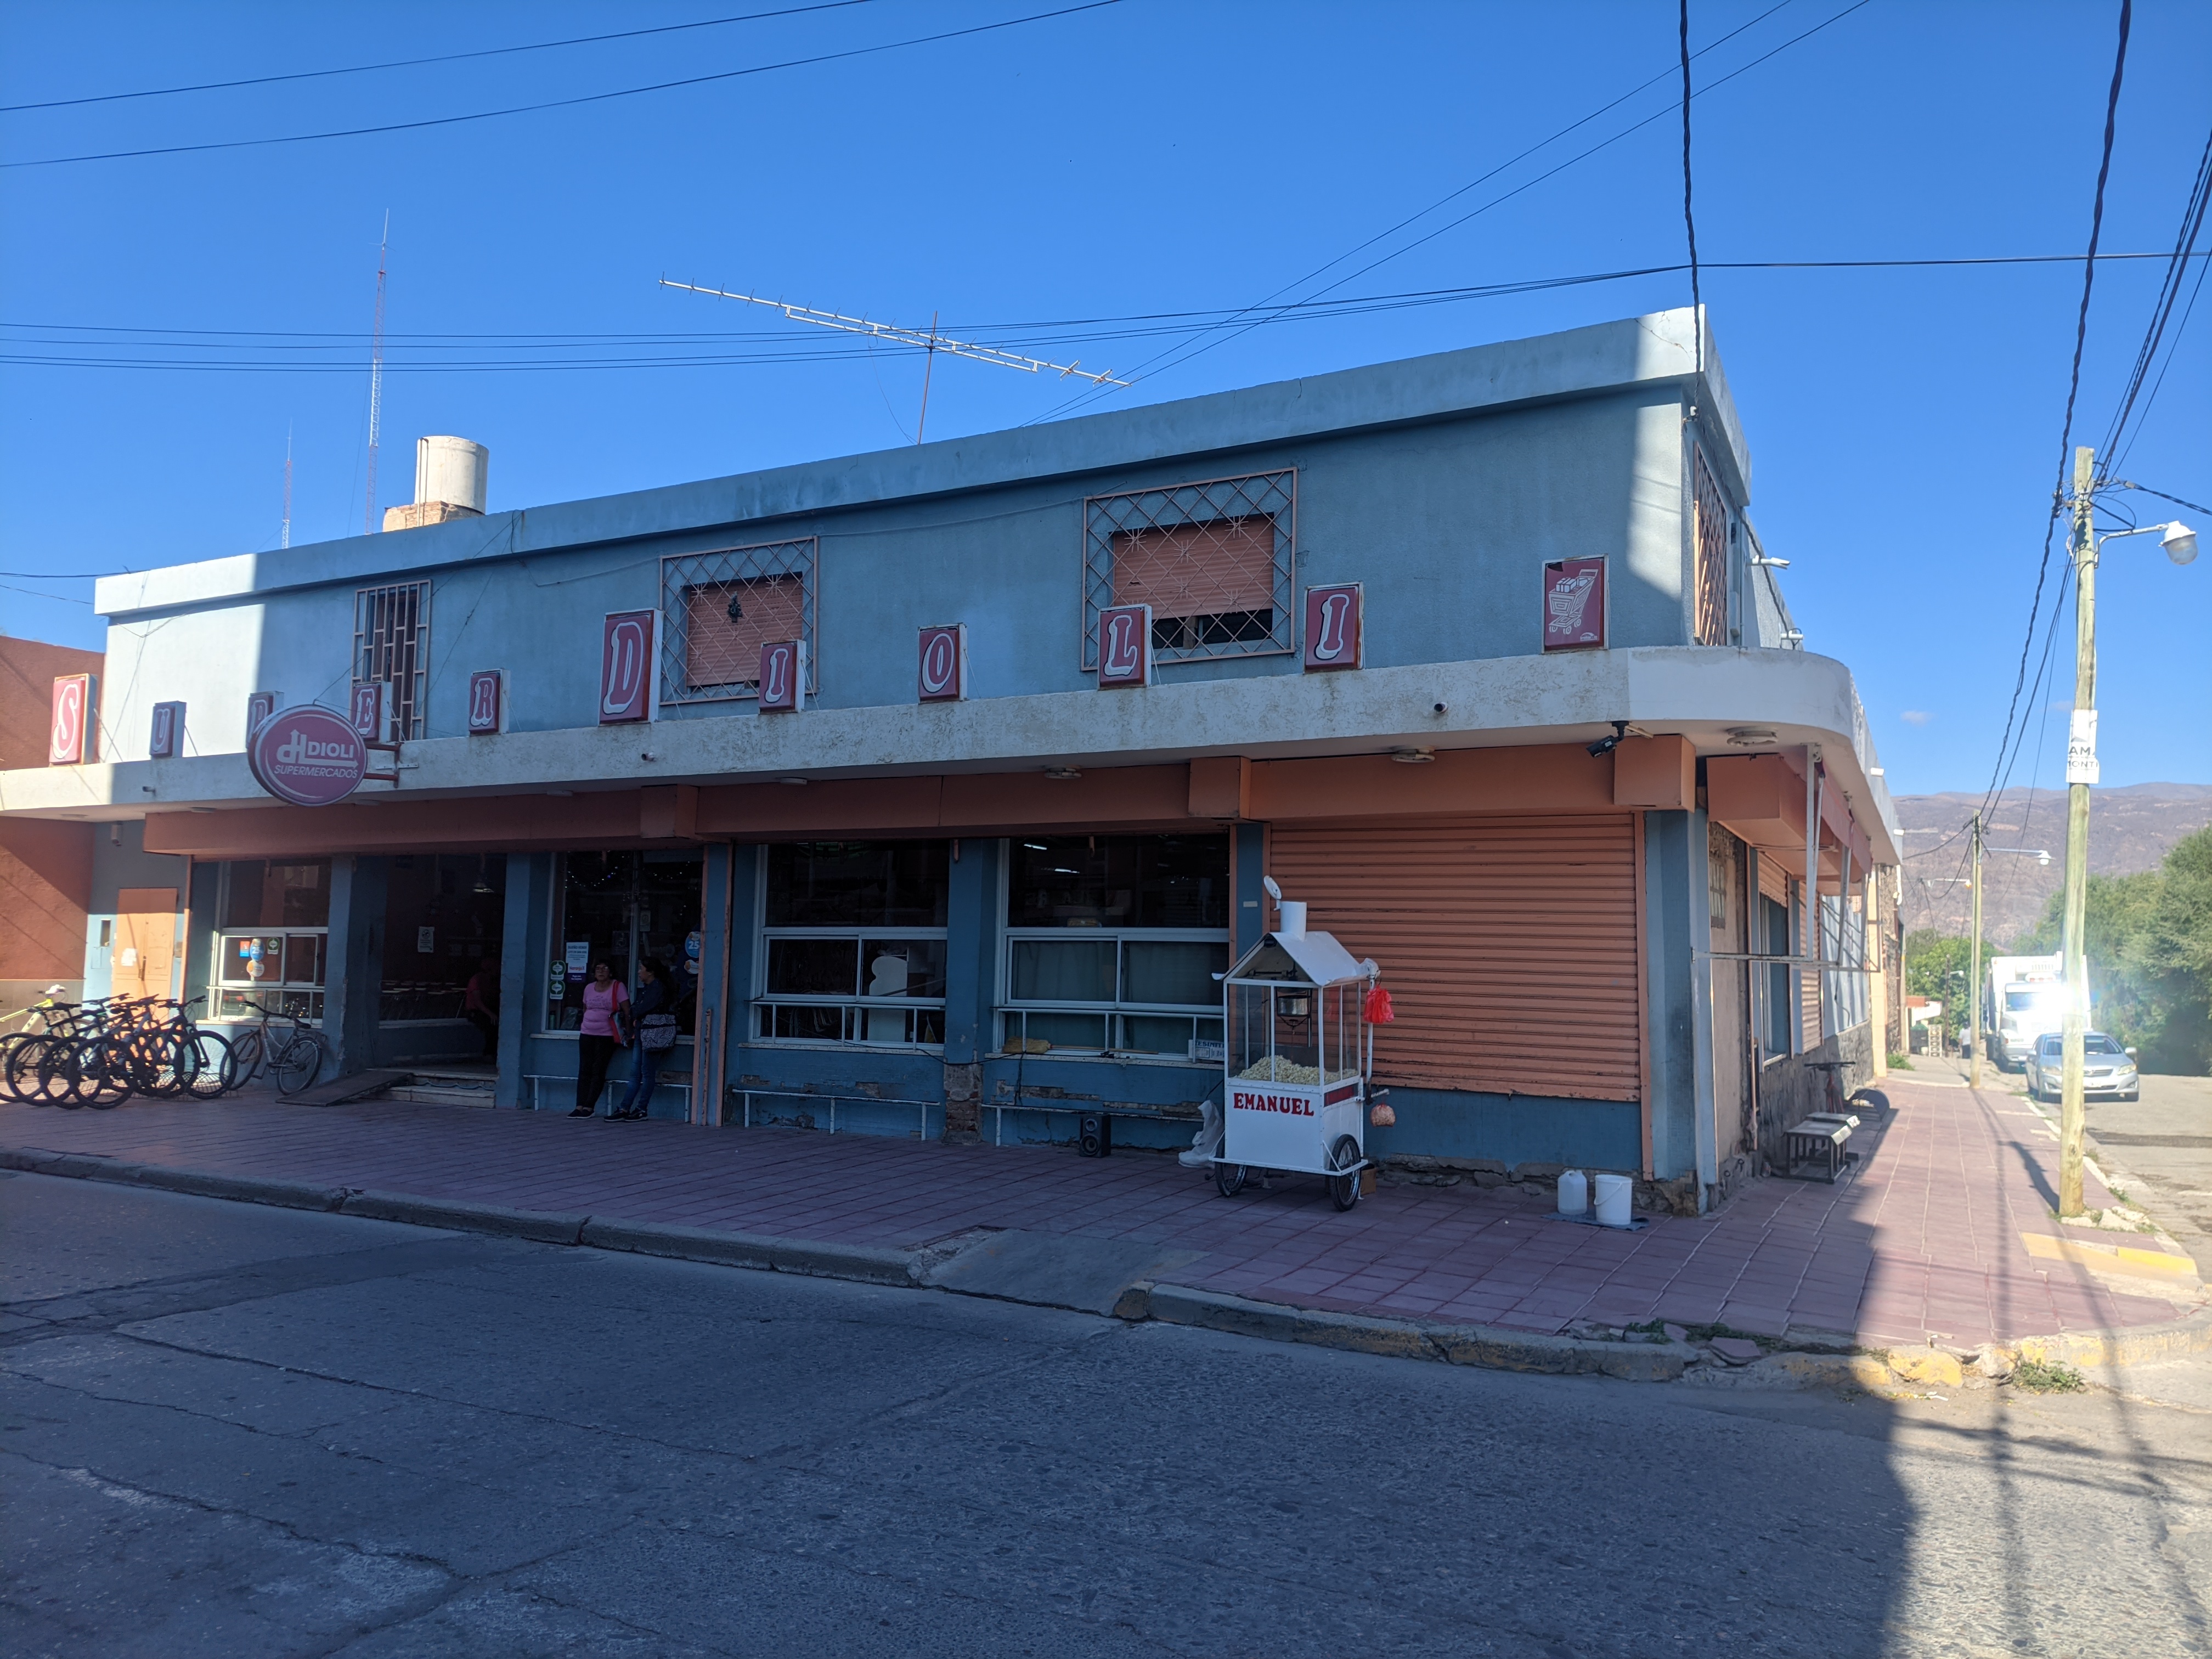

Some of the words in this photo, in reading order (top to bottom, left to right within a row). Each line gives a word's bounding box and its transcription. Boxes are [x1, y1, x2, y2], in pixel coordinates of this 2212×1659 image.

[308, 741, 354, 758] DIOLI
[274, 765, 358, 779] SUPERMERCADOS
[1233, 1092, 1314, 1116] EMANUEL
